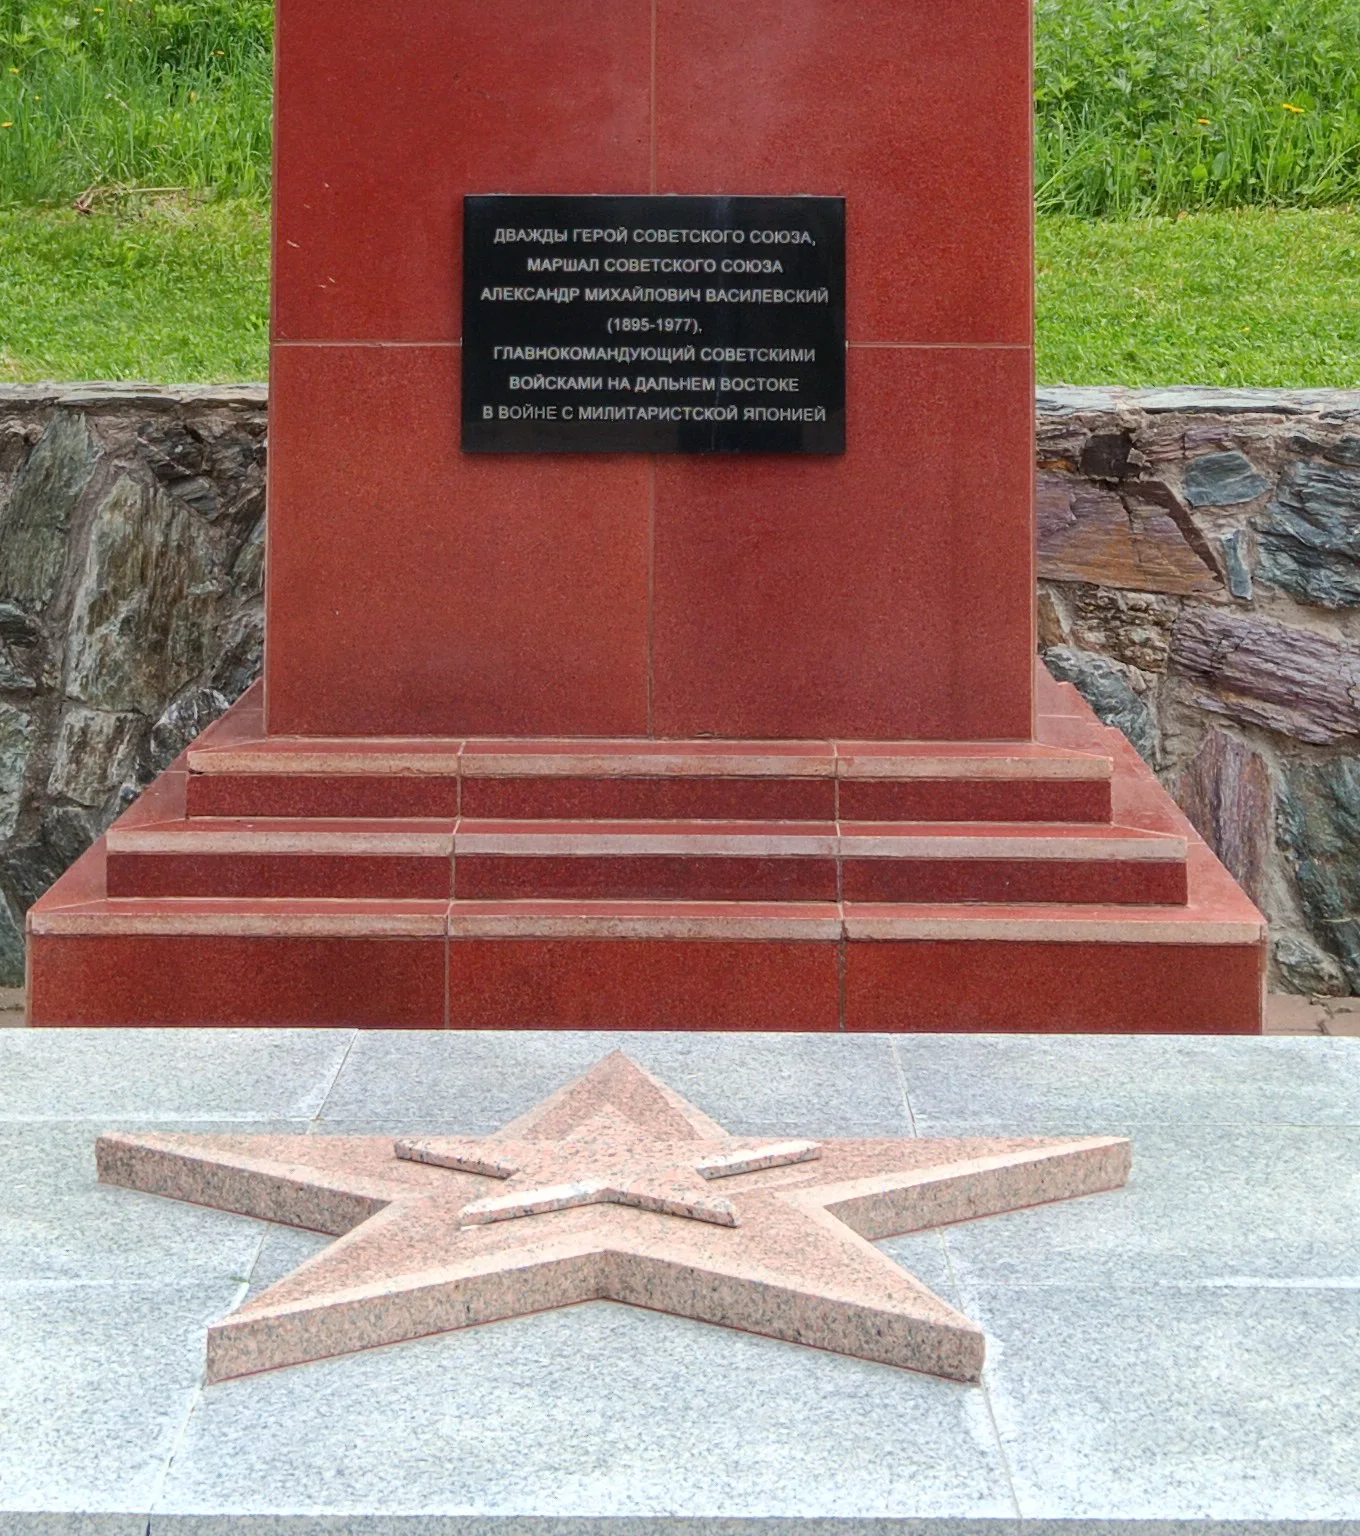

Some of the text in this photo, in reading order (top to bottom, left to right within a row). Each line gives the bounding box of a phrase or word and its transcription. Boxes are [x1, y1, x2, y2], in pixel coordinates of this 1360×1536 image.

[494, 226, 816, 247] ДВАЖДЫ ГЕРОЙ СОВЕТСКОГО СОЮЗА,
[527, 258, 783, 273] МАРШАЛ СОВЕТСКОГО СОЮЗА
[481, 285, 829, 303] АЛЕКСАНДР МИХАЙЛОВИЧ ВАСИЛЕВСКИЙ
[494, 345, 816, 364] ГЛАВНОКОМАНДУЮЩИЙ СОВЕТСКИМИ
[509, 374, 800, 393] ВОЙСКАМИ НА ДАЛЬНЕМ ВОСТОКЕ
[483, 403, 826, 422] В ВОЙНЕ С МИЛИТАРИСТСКОЙ ЯПОНИЕЙ
